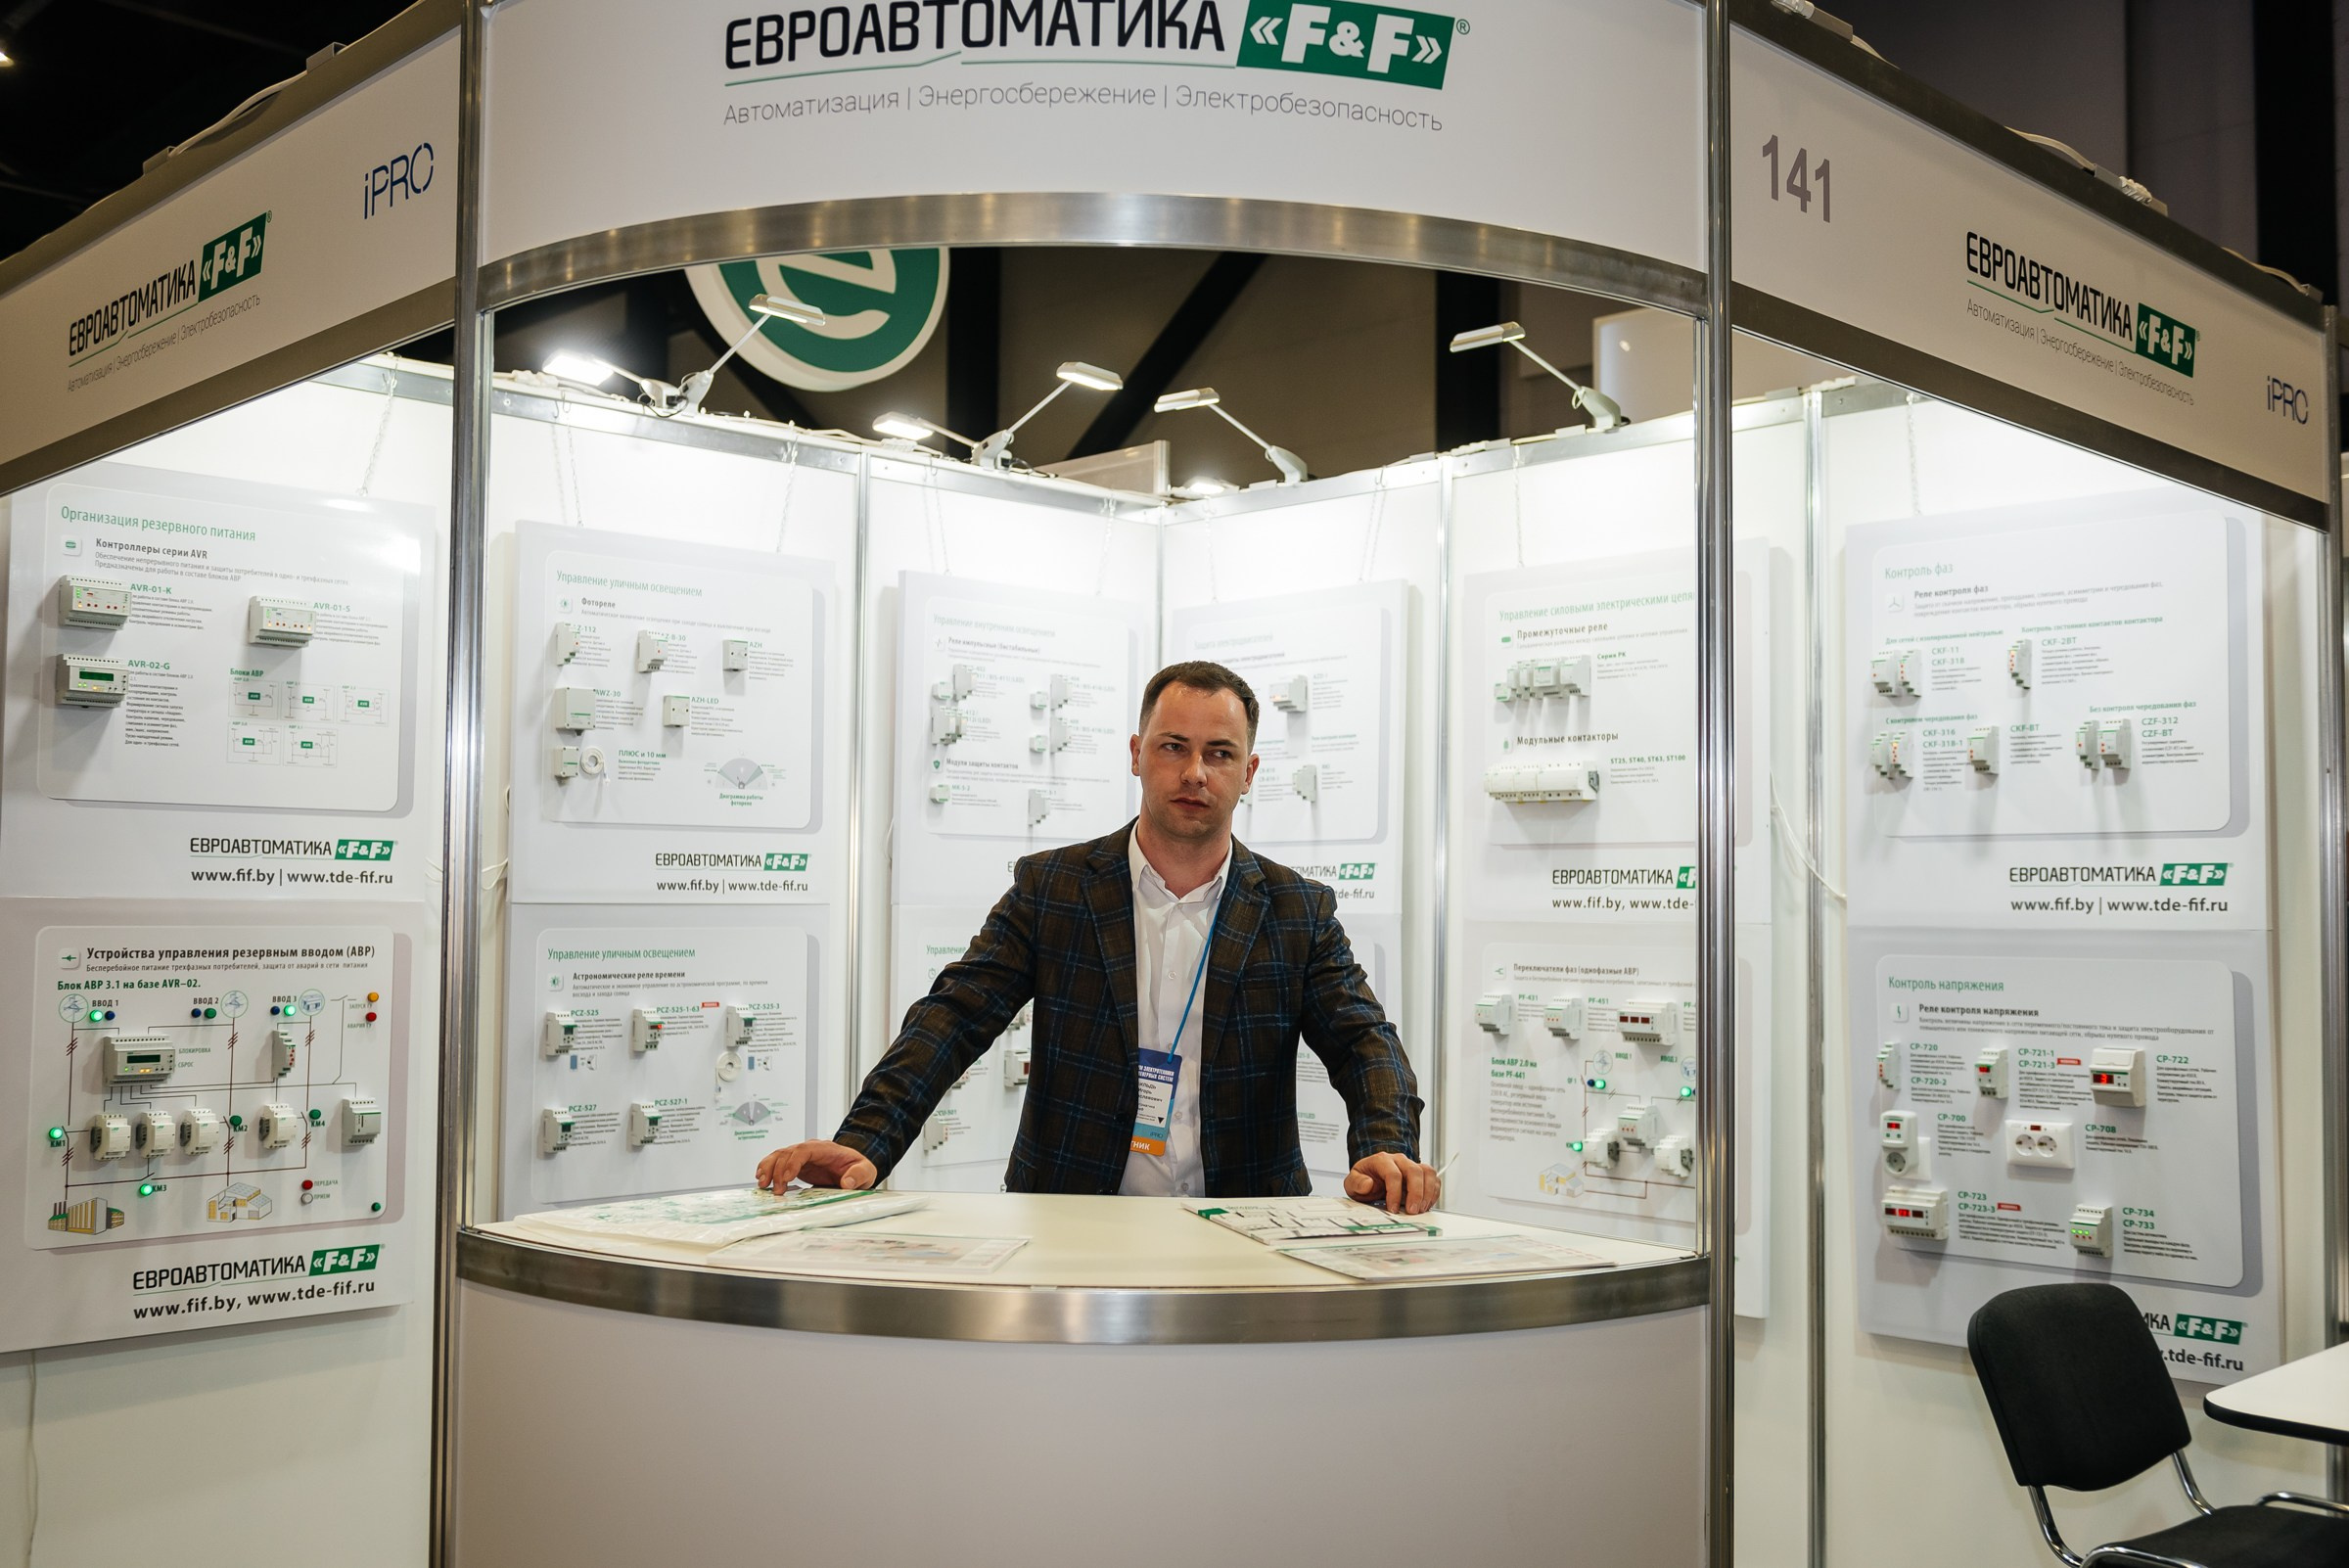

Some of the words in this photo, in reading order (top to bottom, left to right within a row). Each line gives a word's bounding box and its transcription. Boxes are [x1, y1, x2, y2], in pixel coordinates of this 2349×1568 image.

[724, 0, 1225, 69] ЕВРОАВТОМАТИКА
[1249, 3, 1443, 73] «F&F»
[723, 90, 899, 125] Автоматизация
[918, 81, 1156, 112] Энергосбережение
[1274, 85, 1443, 132] Электробезопасность
[364, 142, 434, 220] iPRO
[1763, 134, 1830, 223] 141
[69, 258, 196, 356] ЕВРОАВТОМАТИКА
[202, 226, 261, 291] «F&F»
[1966, 231, 2133, 341] ЕВРОАВТОМАТИКА
[2139, 313, 2193, 365] «F&F»
[67, 358, 114, 392] Автоматизация
[115, 329, 177, 372] Энергосбережение
[180, 296, 260, 341] Электробезопасность
[1966, 299, 2035, 341] Автоматизация
[2040, 329, 2114, 372] Энергосбережение
[2118, 360, 2194, 406] Электробезопасность
[2267, 376, 2308, 424] iPRO
[61, 505, 139, 530] Организация
[141, 516, 207, 539] резервного
[210, 527, 256, 541] питания
[95, 537, 161, 555] Контроллеры
[162, 546, 190, 559] серии
[191, 549, 208, 560] AVR
[1885, 566, 1932, 579] Контроль
[1934, 562, 1954, 577] фаз
[130, 583, 171, 594] AVR-01-K
[557, 570, 607, 587] Управление
[610, 577, 648, 591] уличным
[651, 585, 703, 597] освещением
[1914, 589, 1933, 599] Реле
[1934, 586, 1972, 597] контроля
[1973, 584, 1989, 595] фаз
[313, 602, 350, 613] AVR-01-S
[581, 597, 616, 610] Фотореле
[1499, 609, 1549, 623] Управление
[1550, 602, 1594, 617] силовыми
[1596, 594, 1669, 612] электрическими
[2021, 625, 2052, 634] Контроль
[2124, 616, 2163, 625] контактора
[1517, 624, 1587, 641] Промежуточные
[1588, 623, 1609, 634] реле
[1920, 632, 1967, 642] изолированной
[1931, 646, 1959, 656] CKF-11
[128, 660, 170, 670] AVR-02-G
[230, 668, 250, 676] Блоки
[691, 696, 719, 705] AZH-LED
[2102, 705, 2135, 714] контроля
[2136, 701, 2183, 711] чередования
[2184, 700, 2197, 709] фаз
[1924, 715, 1965, 723] чередования
[2142, 716, 2179, 726] CZF-312
[1922, 728, 1956, 737] CKF-316
[2009, 723, 2041, 733] CKF-BT
[2142, 728, 2174, 739] CZF-BT
[1517, 736, 1565, 747] Модульные
[1568, 733, 1619, 744] контакторы
[619, 750, 639, 759] ПЛЮС
[190, 837, 332, 855] ЕВРОАВТОМАТИКА
[338, 841, 391, 858] «F&F»
[656, 853, 761, 867] ЕВРОАВТОМАТИКА
[766, 854, 806, 870] «F&F»
[192, 869, 275, 885] www.fif.by
[288, 870, 392, 884] www.tde-fif.ru
[1552, 869, 1674, 885] ЕВРОАВТОМАТИКА
[2009, 867, 2156, 883] ЕВРОАВТОМАТИКА
[2161, 865, 2225, 885] «F&F»
[657, 879, 719, 894] www.fif.by
[728, 880, 808, 892] www.tde-fif.ru
[1552, 897, 1626, 912] www.fif.by,
[2011, 898, 2095, 915] www.fif.by
[2107, 898, 2229, 912] www.tde-fif.ru
[87, 947, 155, 961] Устройства
[159, 947, 229, 961] управления
[233, 948, 298, 960] резервным
[301, 948, 343, 958] вводом
[345, 945, 375, 958] (АВР)
[548, 948, 599, 962] Управление
[601, 949, 641, 961] уличным
[643, 948, 696, 959] освещением
[86, 964, 139, 973] Бесперебойное
[171, 963, 211, 973] трехфазных
[1513, 963, 1565, 974] Переключатели
[1566, 965, 1578, 976] фаз
[1578, 965, 1623, 976] (однофазные
[1624, 967, 1639, 976] АВР)
[573, 972, 636, 982] Астрономические
[637, 972, 655, 981] реле
[656, 972, 686, 981] времени
[57, 981, 81, 990] Блок
[84, 981, 103, 990] АВР
[107, 980, 120, 989] 3.1
[137, 979, 160, 989] базе
[1889, 977, 1937, 992] Контроль
[1939, 980, 2004, 993] напряжения
[92, 999, 113, 1008] ВВОД
[1918, 1003, 1939, 1014] Реле
[1941, 1006, 1981, 1016] контроля
[1983, 1007, 2040, 1017] напряжения
[1910, 1042, 1938, 1051] CP-720
[2018, 1047, 2054, 1057] CP-721-1
[1491, 1057, 1506, 1066] Блок
[1507, 1058, 1519, 1067] АВР
[2018, 1060, 2055, 1070] CP-721-3
[2156, 1054, 2189, 1065] CP-722
[1491, 1069, 1505, 1079] базе
[1505, 1070, 1526, 1080] PF-441
[1911, 1077, 1947, 1086] CP-720-2
[569, 1104, 597, 1113] PCZ-527
[655, 1098, 688, 1107] PCZ-527-1
[1937, 1113, 1966, 1123] CP-700
[2085, 1124, 2117, 1134] CP-708
[50, 1139, 66, 1148] КМ1
[1958, 1190, 1987, 1201] CP-723
[1958, 1202, 1996, 1214] CP-723-3
[2122, 1207, 2155, 1218] CP-734
[2122, 1219, 2155, 1229] CP-733
[133, 1255, 306, 1290] ЕВРОАВТОМАТИКА
[312, 1248, 377, 1273] «F&F»
[133, 1295, 241, 1319] www.fif.by,
[248, 1281, 375, 1306] www.tde-fif.ru
[2177, 1316, 2239, 1340] «F&F»
